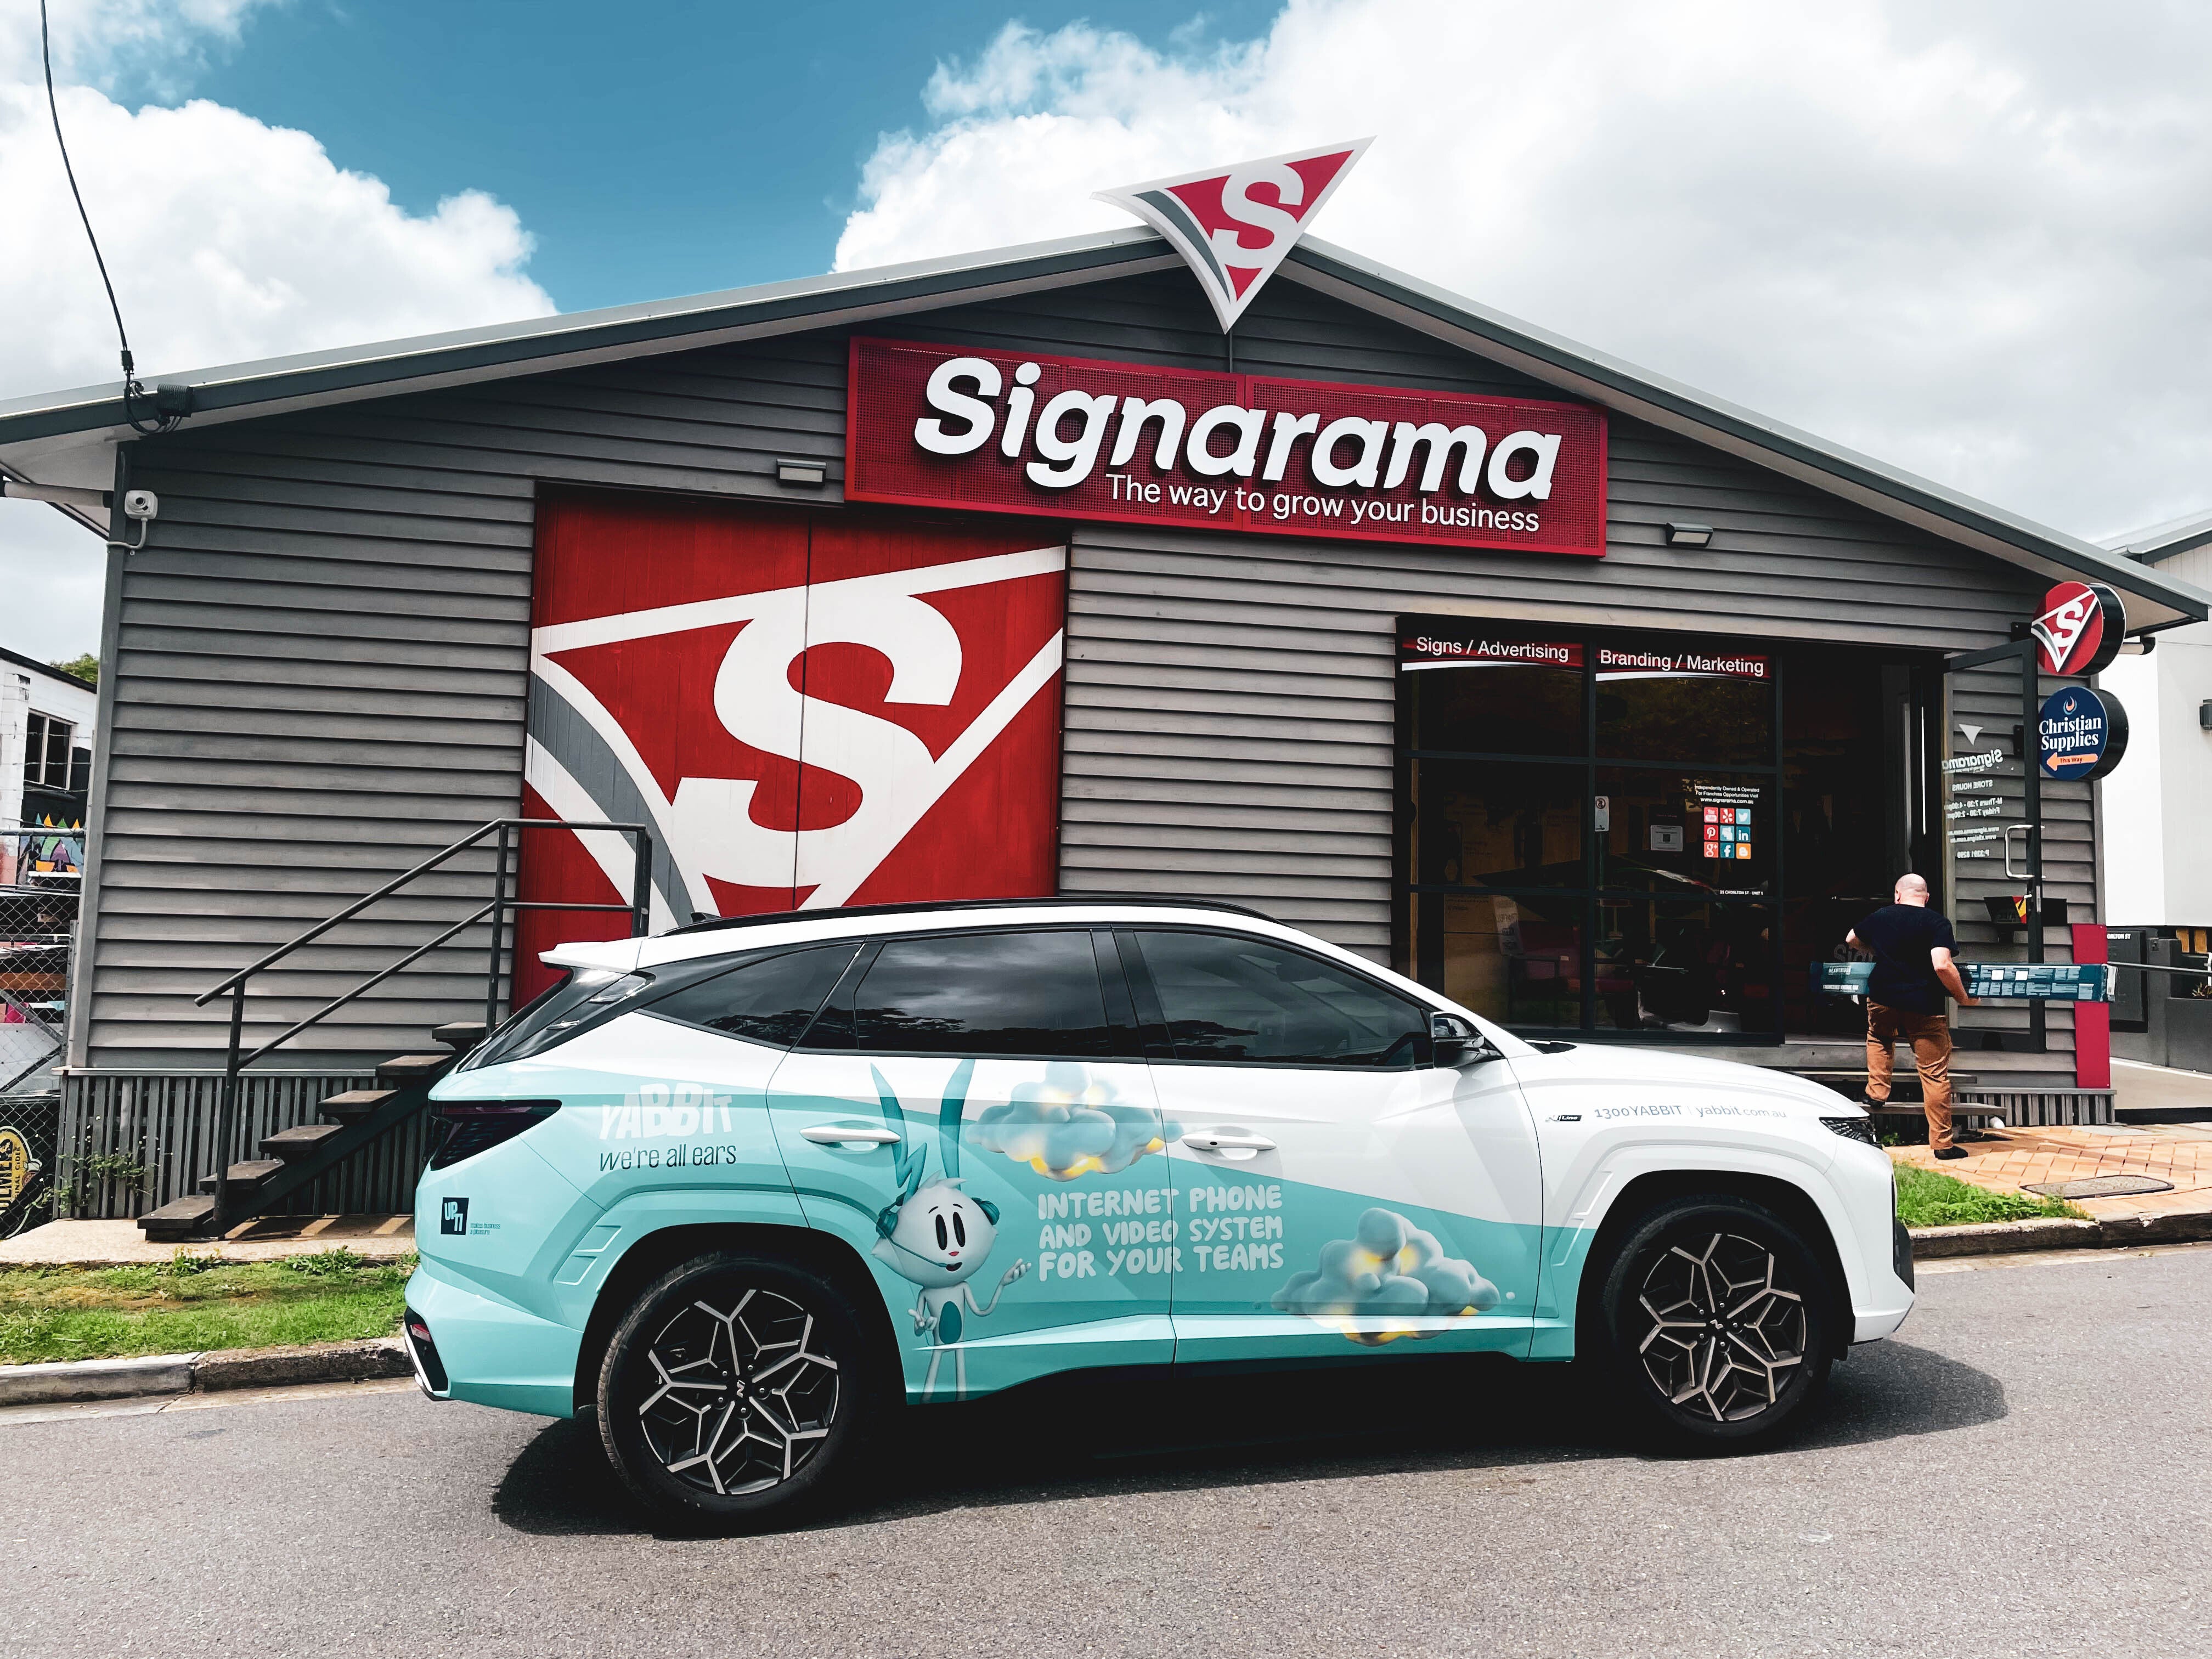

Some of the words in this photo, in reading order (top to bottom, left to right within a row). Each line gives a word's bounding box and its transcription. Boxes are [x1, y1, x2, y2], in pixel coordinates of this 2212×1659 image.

[915, 357, 1562, 500] Signarama
[1106, 473, 1161, 503] The
[1169, 484, 1227, 514] way
[1235, 487, 1265, 511] to
[1273, 493, 1344, 520] grow
[1350, 499, 1415, 524] your
[1421, 498, 1539, 532] business
[1416, 636, 1462, 656] Signs
[1466, 639, 1474, 654] /
[1477, 640, 1569, 663] Advertising
[1600, 649, 1671, 671] Branding
[1675, 654, 1683, 669] /
[1686, 655, 1764, 677] Marketing
[2039, 715, 2102, 735] Christian
[2041, 731, 2099, 752] Supplies
[599, 1082, 733, 1141] YABBIT
[1594, 1105, 1682, 1120] 1300YABBIT
[600, 1146, 659, 1172] we're
[666, 1144, 686, 1168] all
[692, 1145, 737, 1166] ears
[1038, 1188, 1180, 1220] INTERNET
[1189, 1184, 1283, 1214] PHONE
[1039, 1222, 1092, 1250] AND
[1102, 1220, 1179, 1246] VIDEO
[1189, 1215, 1283, 1242] SYSTEM
[1039, 1250, 1097, 1282] FOR
[1106, 1246, 1183, 1277] YOUR
[1193, 1243, 1284, 1273] TEAMS
